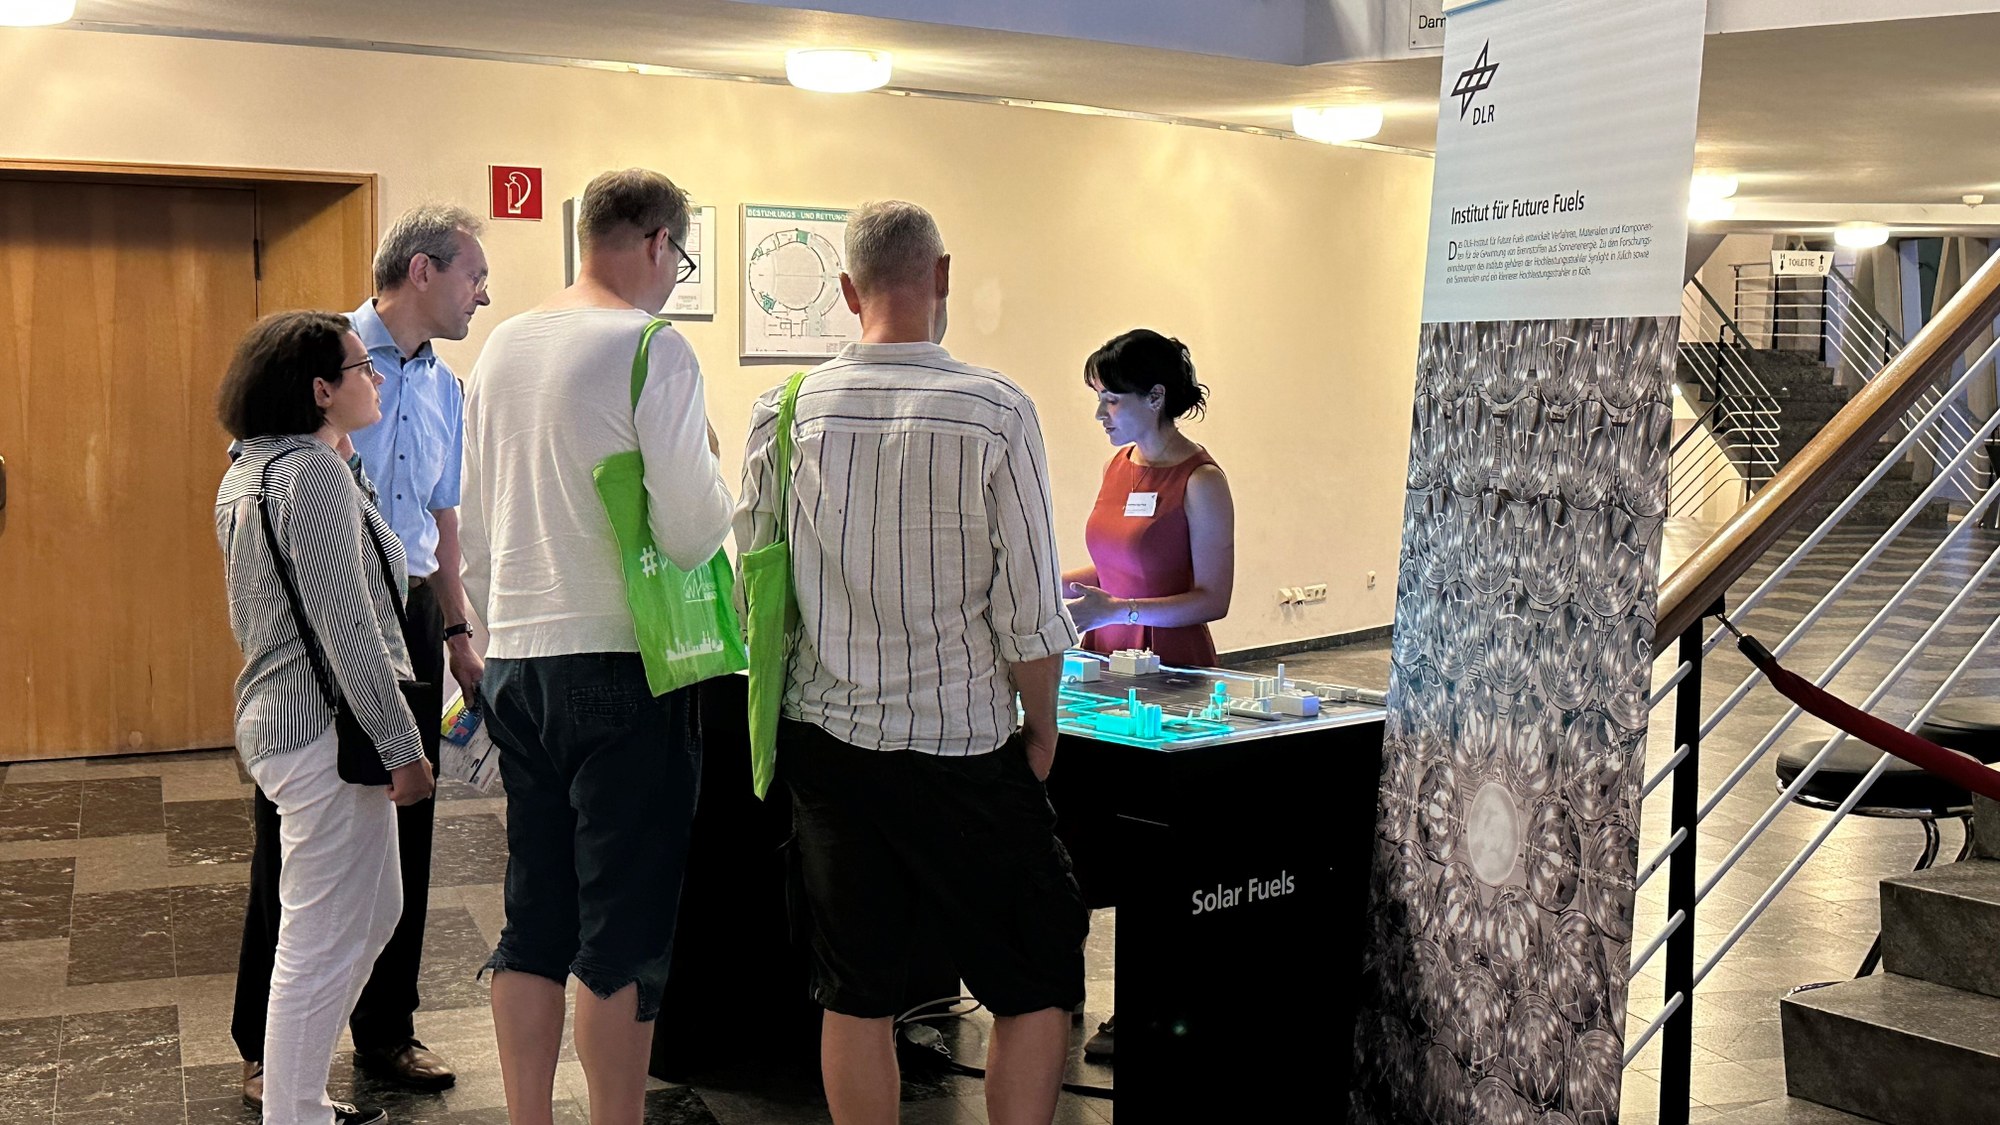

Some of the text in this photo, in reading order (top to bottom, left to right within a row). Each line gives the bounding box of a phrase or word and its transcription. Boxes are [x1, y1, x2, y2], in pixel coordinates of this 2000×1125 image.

[1472, 104, 1495, 125] DLR
[1451, 189, 1585, 225] Institut für Future Fuels
[1609, 224, 1620, 235] und
[1621, 223, 1654, 235] Komponen-
[1599, 238, 1607, 248] Zu
[1619, 235, 1652, 248] Forschungs-
[1789, 258, 1815, 266] TOILETTE
[1192, 869, 1295, 915] Solar Fuels
